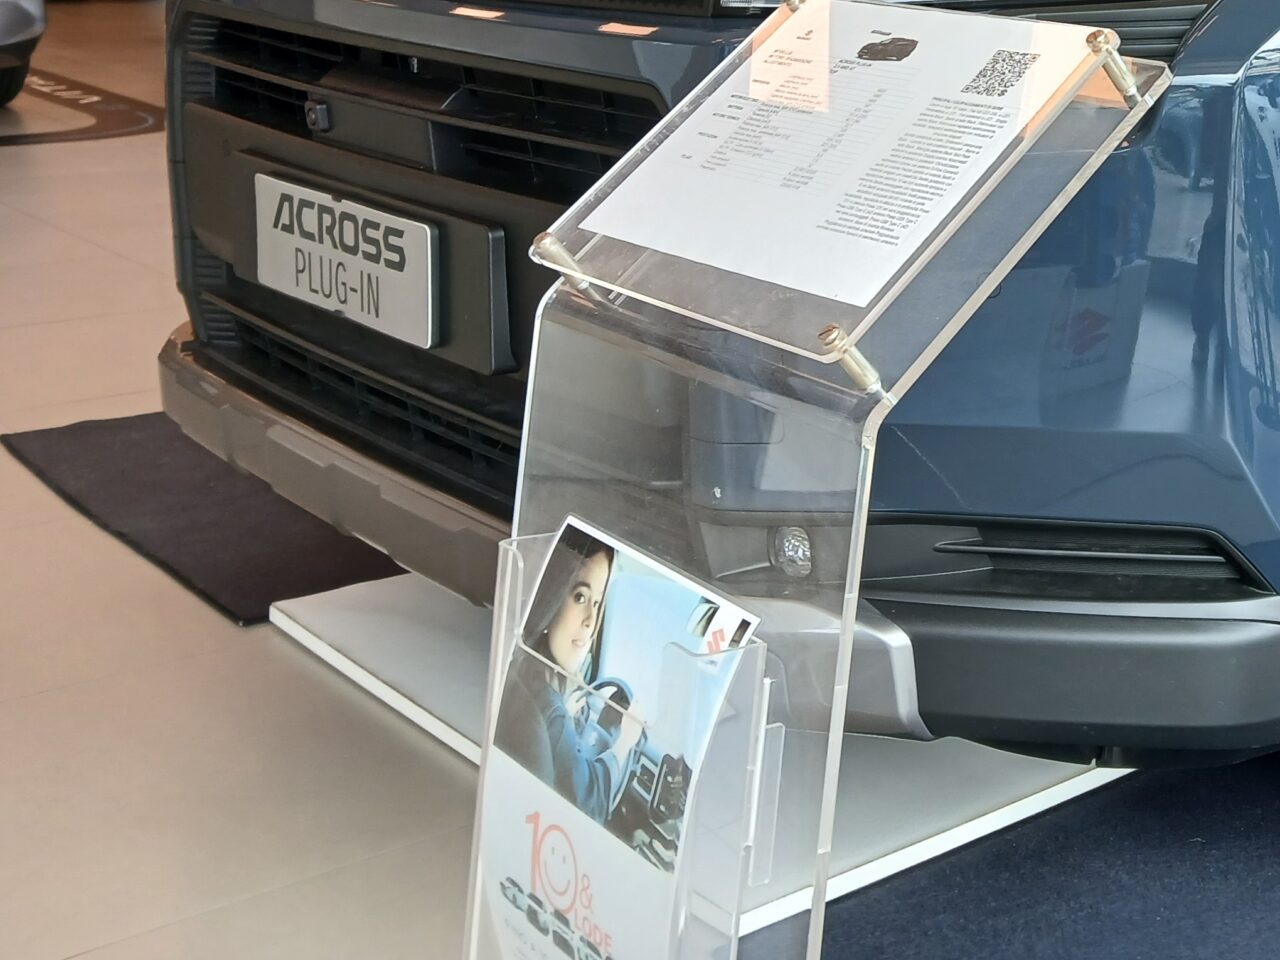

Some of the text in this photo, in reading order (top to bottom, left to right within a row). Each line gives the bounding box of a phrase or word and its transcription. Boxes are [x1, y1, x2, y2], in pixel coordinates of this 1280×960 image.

[272, 192, 407, 273] ACROSS
[294, 246, 380, 319] PLUG-IN
[579, 873, 592, 909] &
[575, 906, 613, 952] LODE
